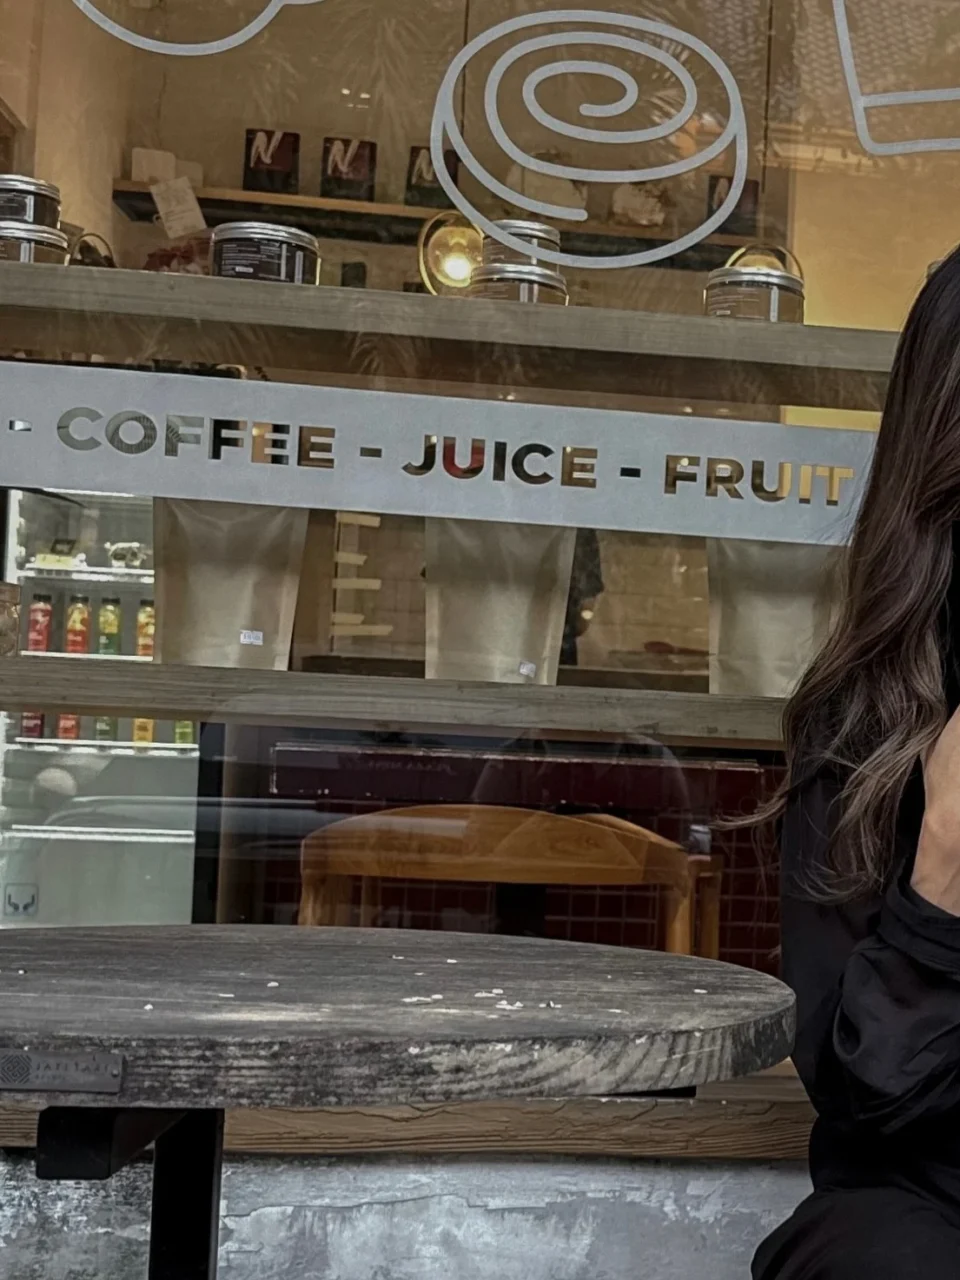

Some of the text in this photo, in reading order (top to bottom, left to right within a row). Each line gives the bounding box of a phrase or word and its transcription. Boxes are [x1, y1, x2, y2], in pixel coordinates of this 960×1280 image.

[57, 407, 336, 469] COFFEE
[401, 434, 598, 489] JUICE
[664, 454, 855, 507] FRUIT
